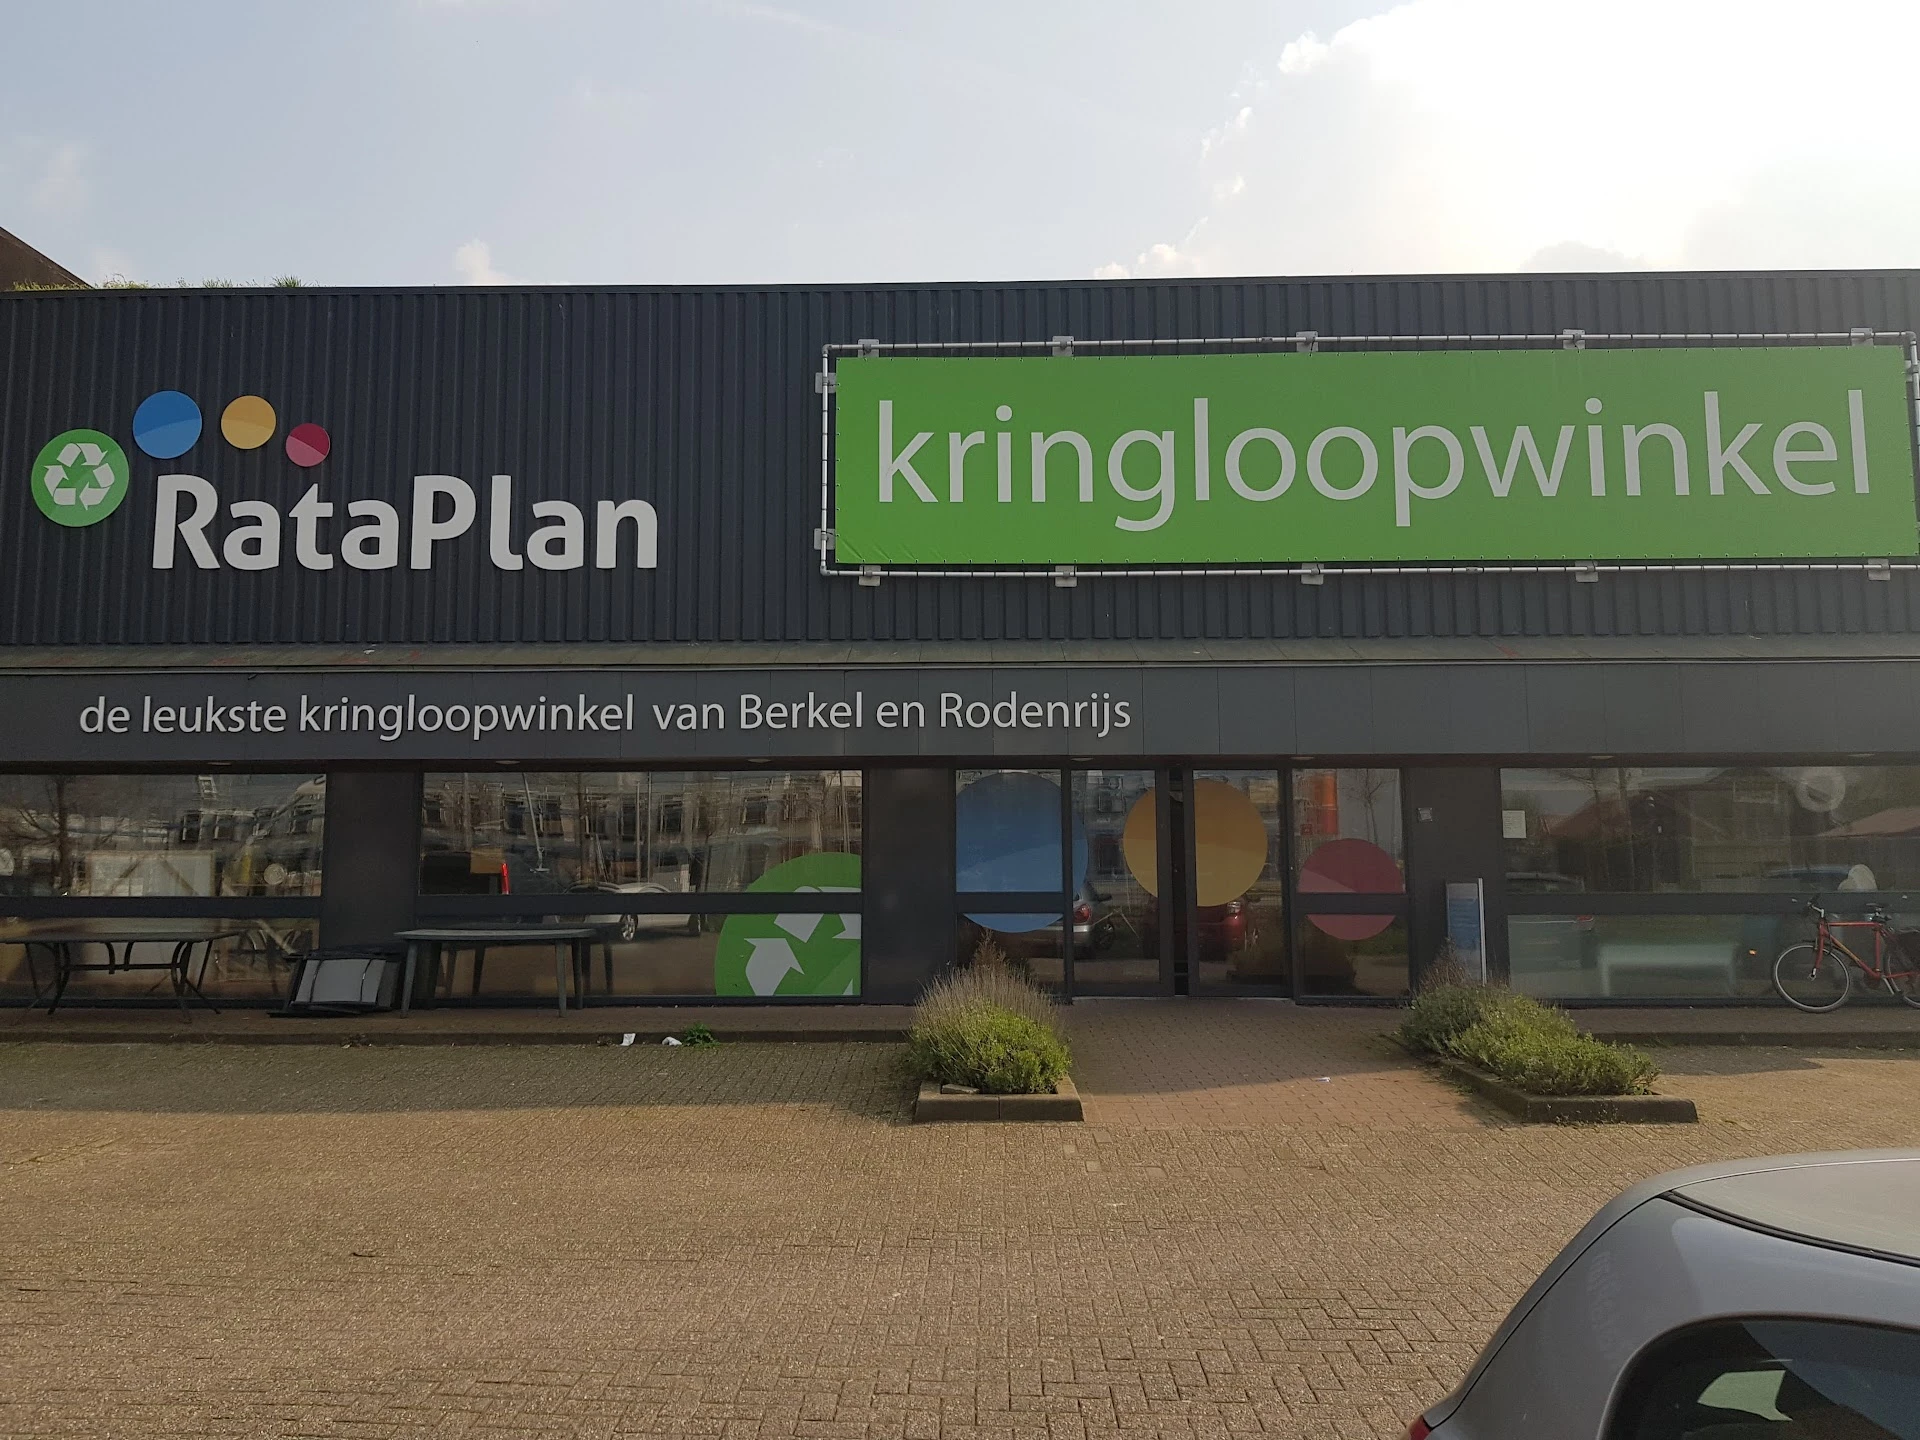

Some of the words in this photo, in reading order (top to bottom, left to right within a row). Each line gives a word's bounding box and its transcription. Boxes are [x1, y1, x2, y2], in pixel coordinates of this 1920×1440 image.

[878, 389, 1870, 532] kringloopwinkel
[152, 474, 658, 571] RataPlan
[79, 695, 130, 733] de
[142, 695, 287, 733] leukste
[299, 693, 633, 741] kringloopwinkel
[652, 702, 725, 731] van
[740, 691, 862, 729] Berkel
[876, 701, 925, 728] en
[940, 690, 1131, 738] Rodenrijs
